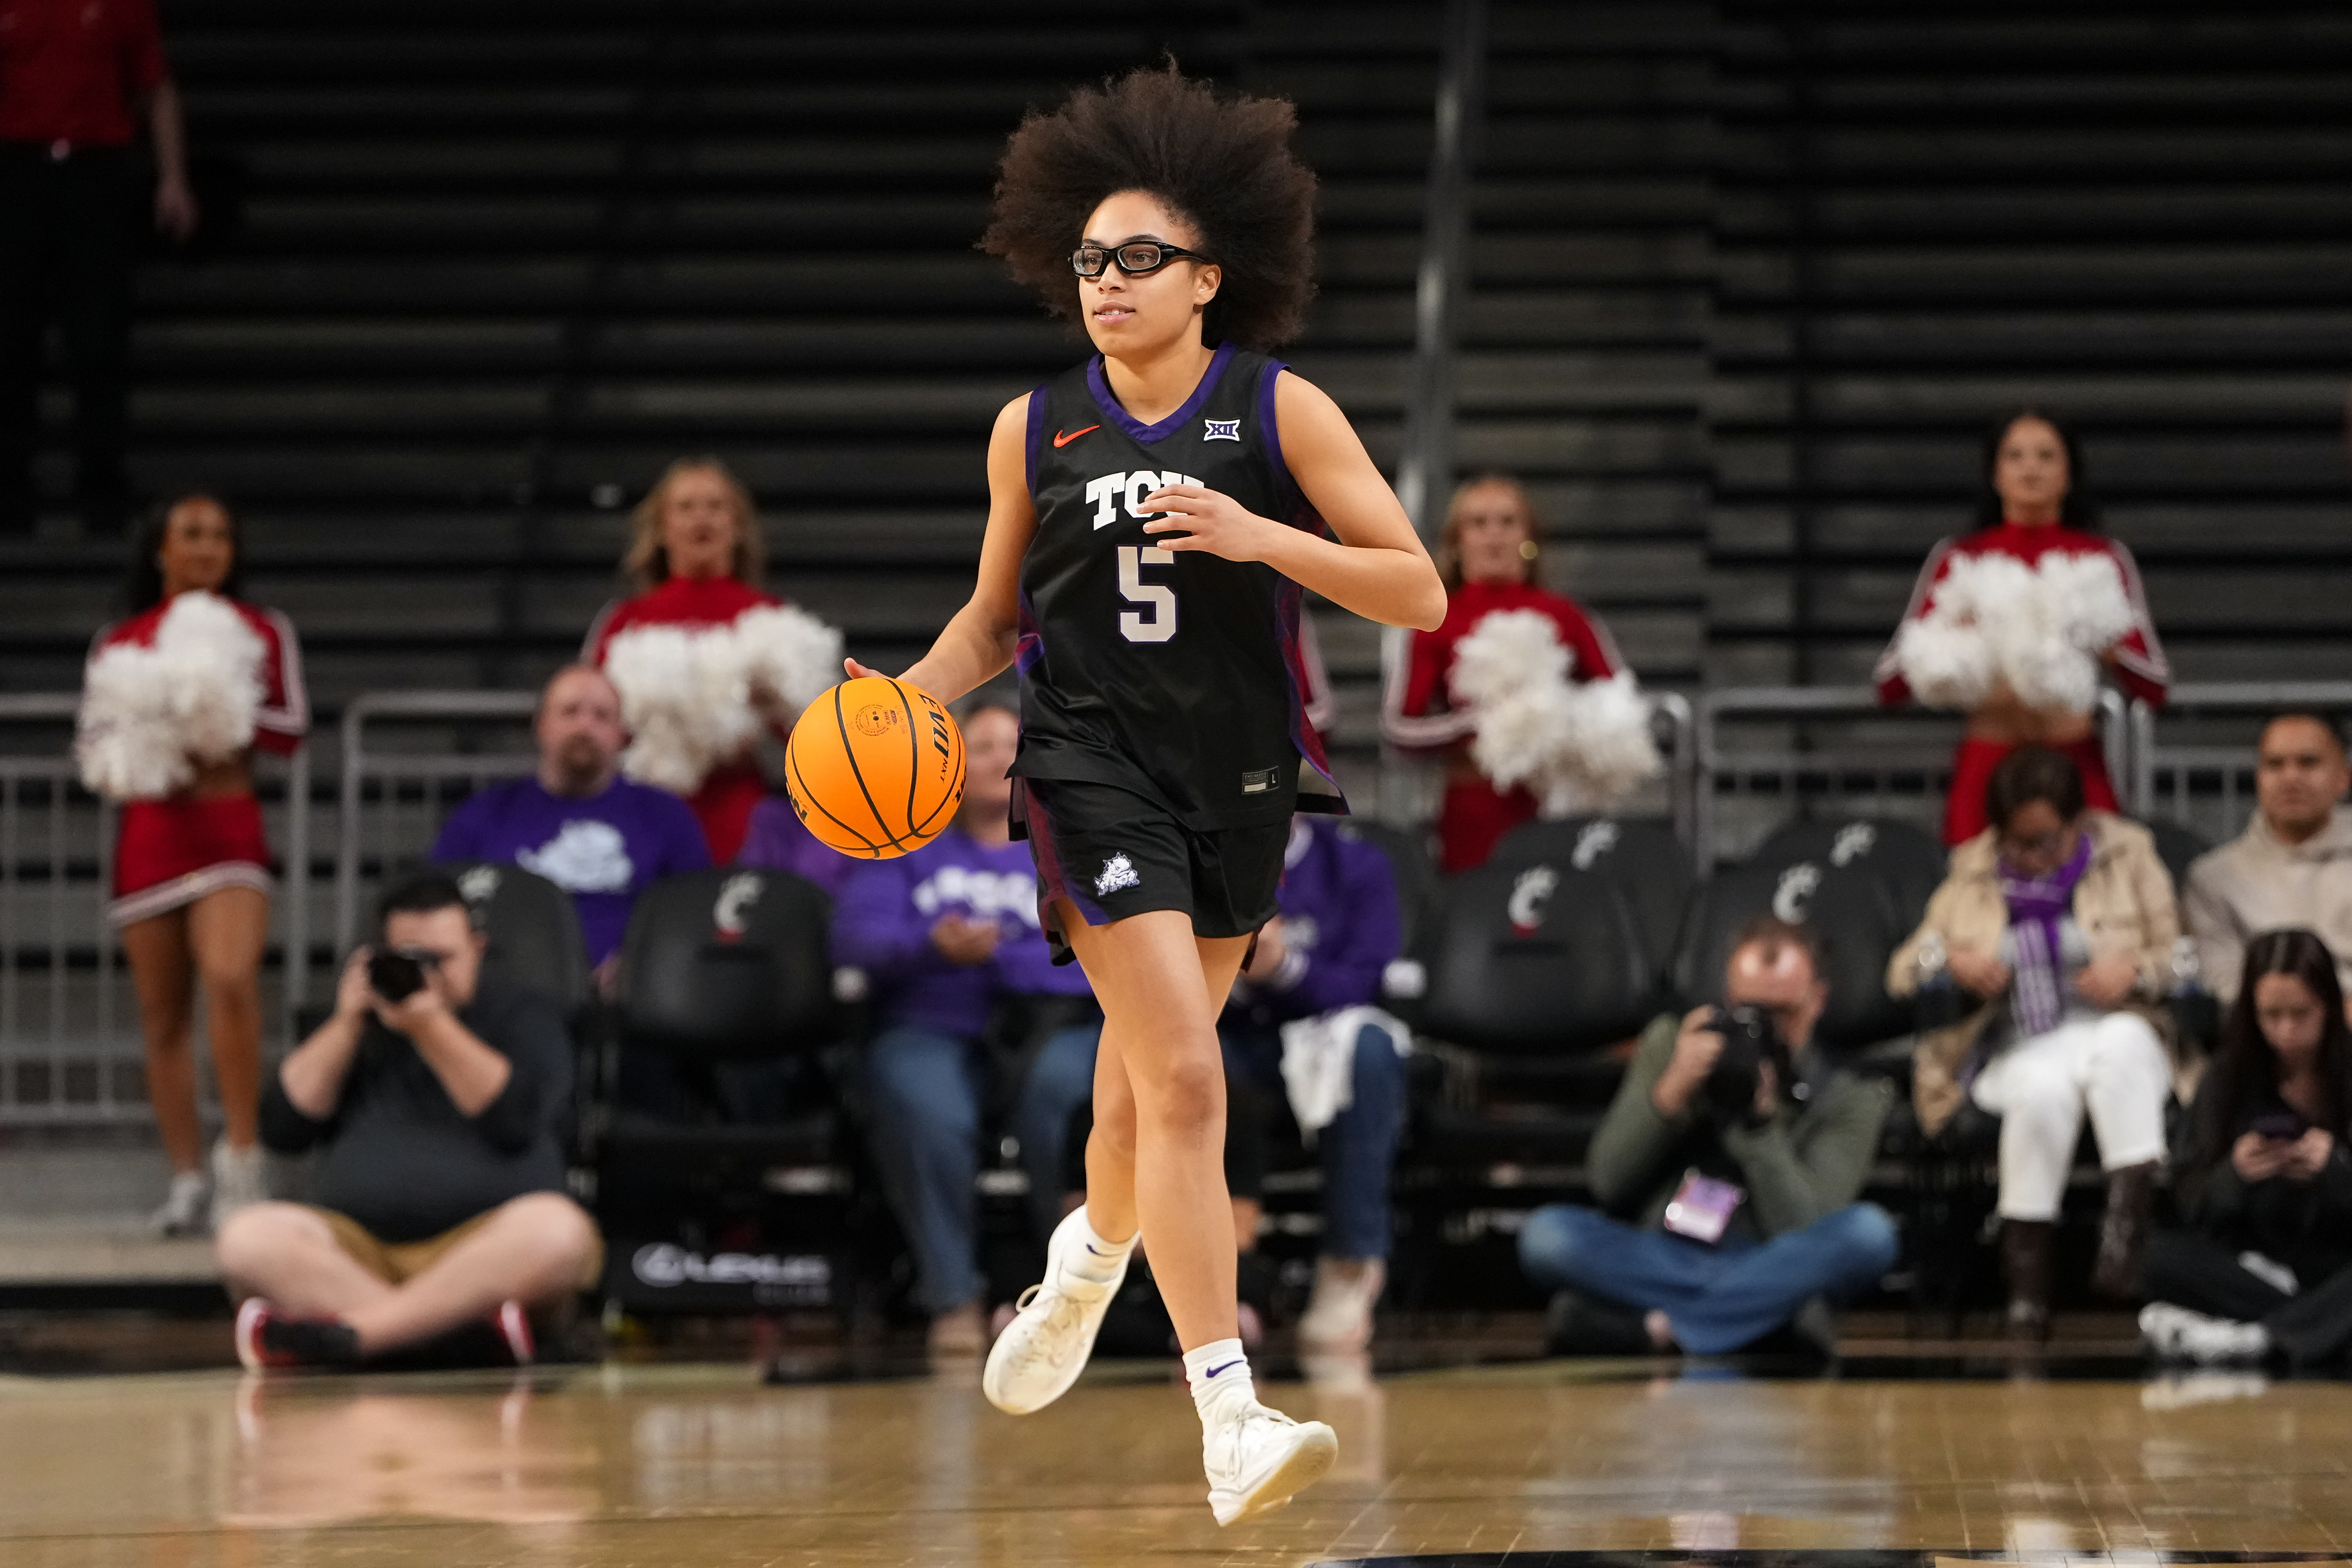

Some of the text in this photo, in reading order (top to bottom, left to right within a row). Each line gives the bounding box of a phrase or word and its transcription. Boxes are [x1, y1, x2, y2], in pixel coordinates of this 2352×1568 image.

[1117, 544, 1179, 643] 5
[918, 693, 949, 784] EVO NXT
[1272, 773, 1276, 783] L
